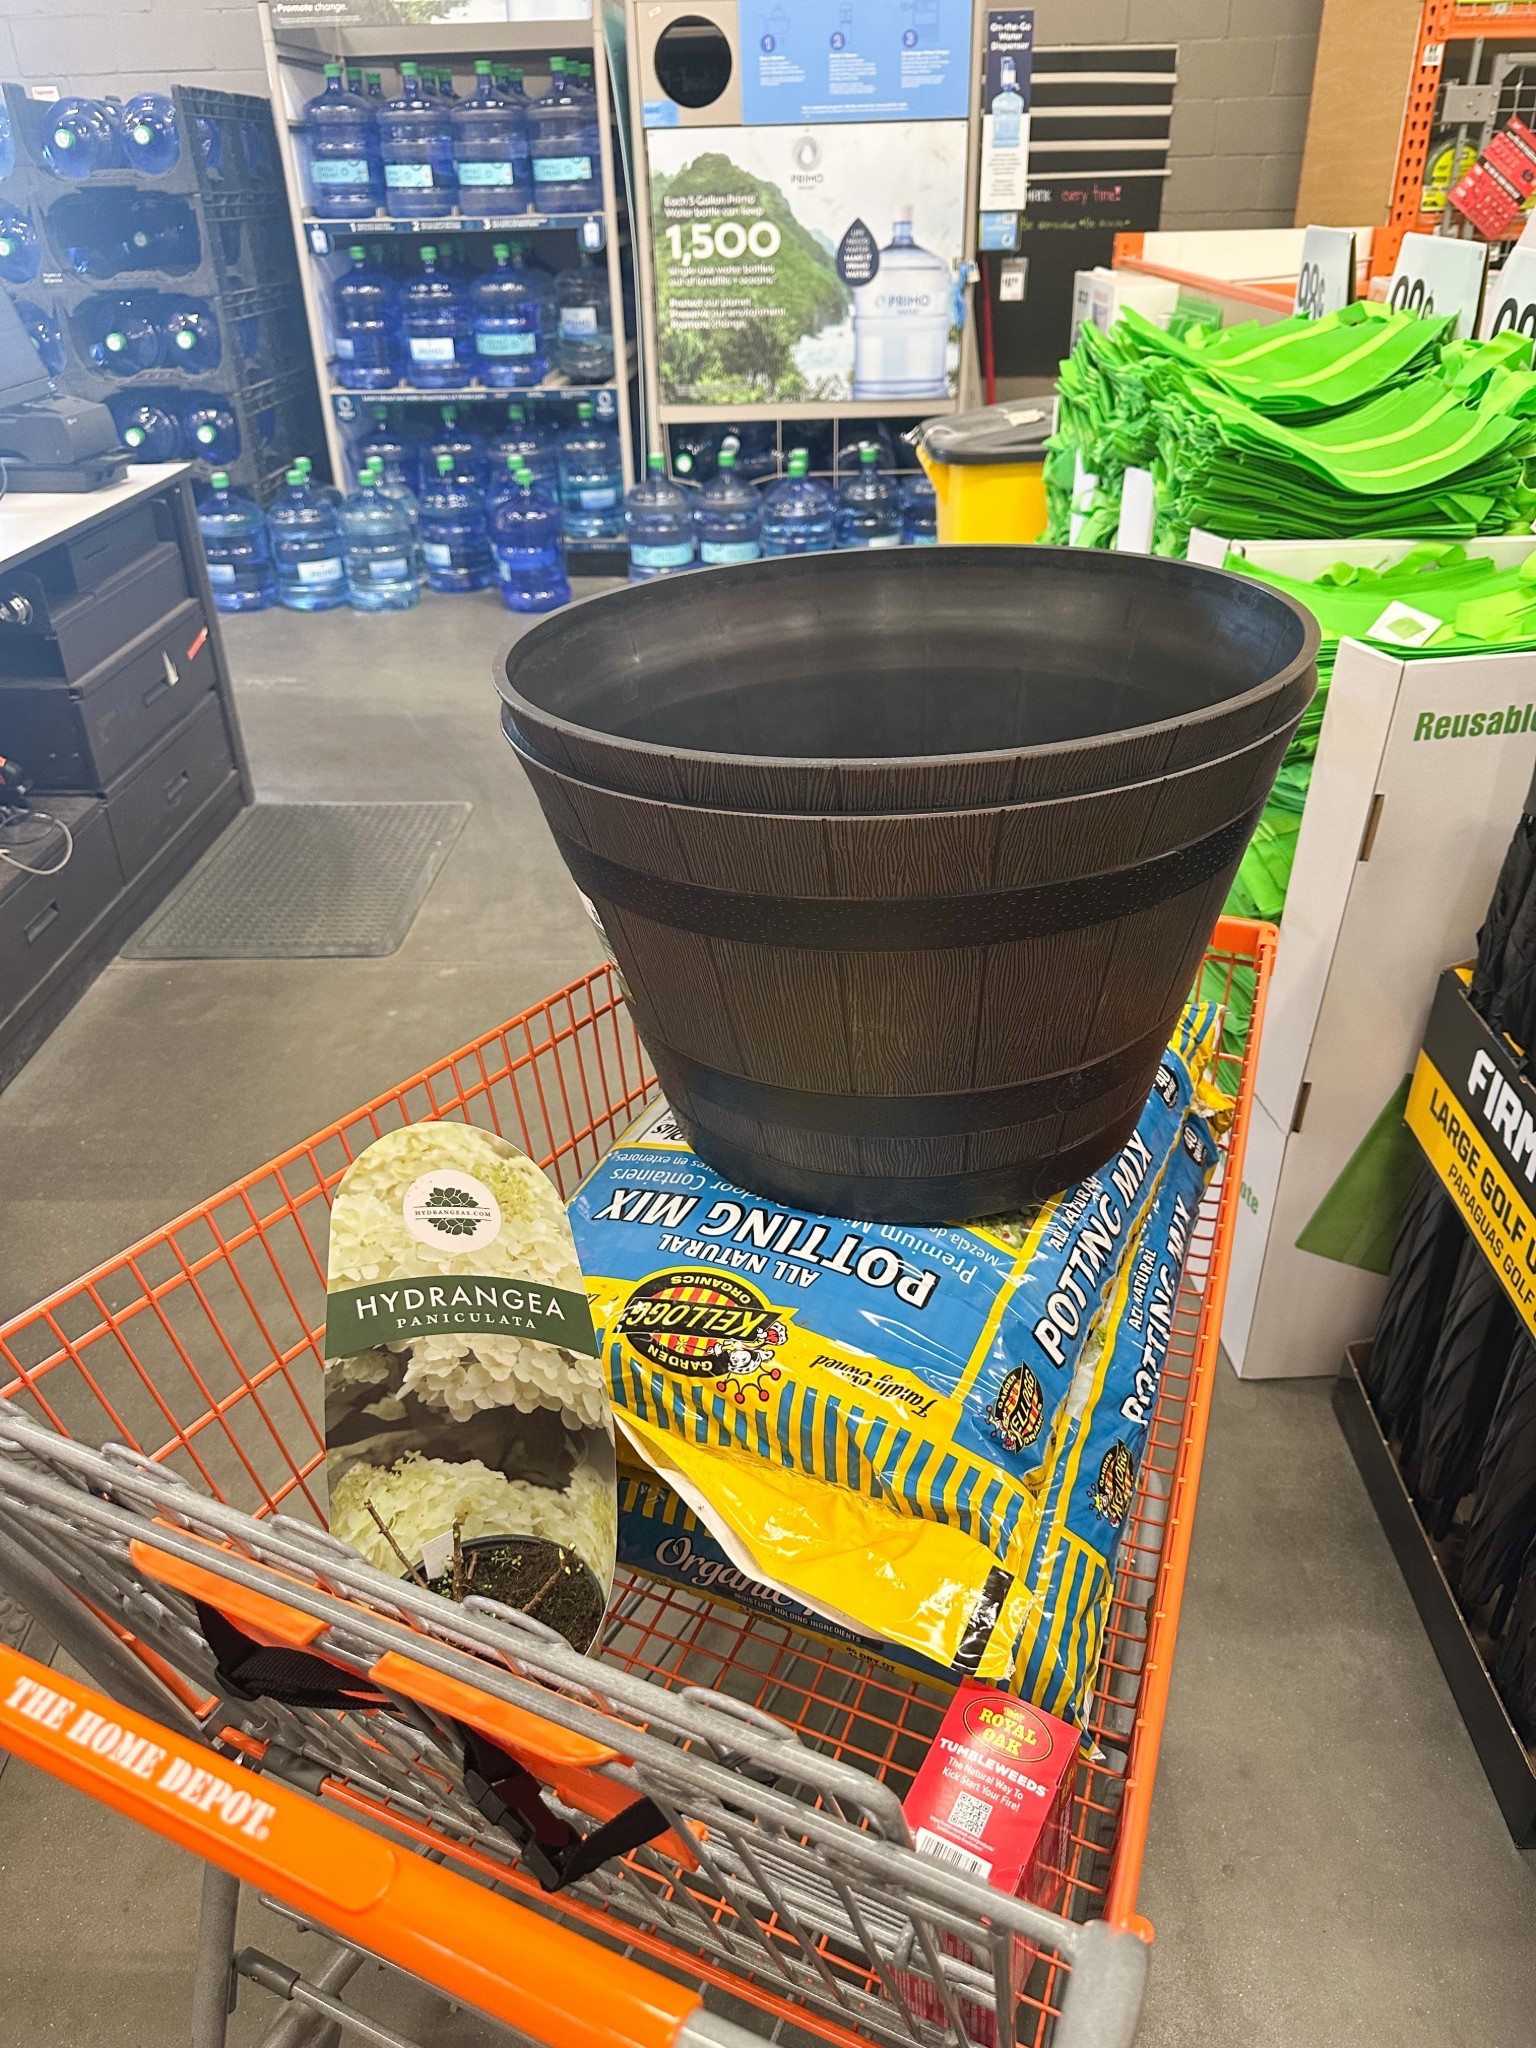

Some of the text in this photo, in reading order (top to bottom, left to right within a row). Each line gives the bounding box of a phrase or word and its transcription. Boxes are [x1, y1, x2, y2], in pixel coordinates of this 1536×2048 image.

[276, 3, 349, 13] Promote change.
[990, 21, 1032, 32] On-the-Go
[998, 32, 1023, 41] Water
[990, 41, 1031, 52] Dispenser
[791, 174, 824, 183] PRIMO
[664, 195, 687, 207] Each
[696, 194, 726, 206] Gallon
[727, 193, 757, 206] Primo
[664, 205, 764, 218] Water bottle can keep
[665, 220, 782, 267] 1,500
[742, 264, 775, 274] bottles
[669, 298, 703, 308] Protect
[703, 299, 720, 307] our
[670, 307, 789, 319] Preserve our environment.
[888, 294, 931, 308] PRIMO
[670, 318, 749, 330] Promote change.
[1183, 1126, 1198, 1150] 40
[673, 1156, 689, 1166] en
[1429, 1087, 1527, 1245] LARGE GOLF
[610, 1168, 707, 1191] Containers
[414, 1209, 492, 1218] HYDRANGEAS.COM
[1063, 1174, 1104, 1229] NATURAL
[592, 1187, 941, 1310] POTTING MIX
[1031, 1128, 1153, 1370] POTTING MIX
[1448, 1162, 1536, 1306] PARAGUAS GOLF
[657, 1232, 822, 1289] ALL NATURAL
[880, 1224, 979, 1285] Premium
[953, 1235, 1000, 1268] Mezcla
[356, 1285, 566, 1321] HYDRANGEA
[670, 1275, 751, 1305] ORGANICS
[396, 1312, 537, 1330] PANICULATA
[647, 1344, 713, 1371] GARDEN
[997, 1372, 1018, 1410] GARDEN
[1007, 1367, 1037, 1446] KELLOGG
[1099, 1452, 1114, 1487] GARDEN
[734, 1592, 774, 1612] MOISTURE
[774, 1606, 809, 1625] HOLDING
[810, 1619, 862, 1644] INGREDIENTS
[4, 1675, 77, 1731] THE
[66, 1709, 168, 1781] HOME
[978, 1707, 1038, 1746] ROYAL
[982, 1728, 1023, 1757] OAK
[939, 1737, 1047, 1798] TUMBLEWEEDS
[948, 1755, 1024, 1800] The Natural Way To
[942, 1767, 1022, 1813] Kick Start Your Fire!
